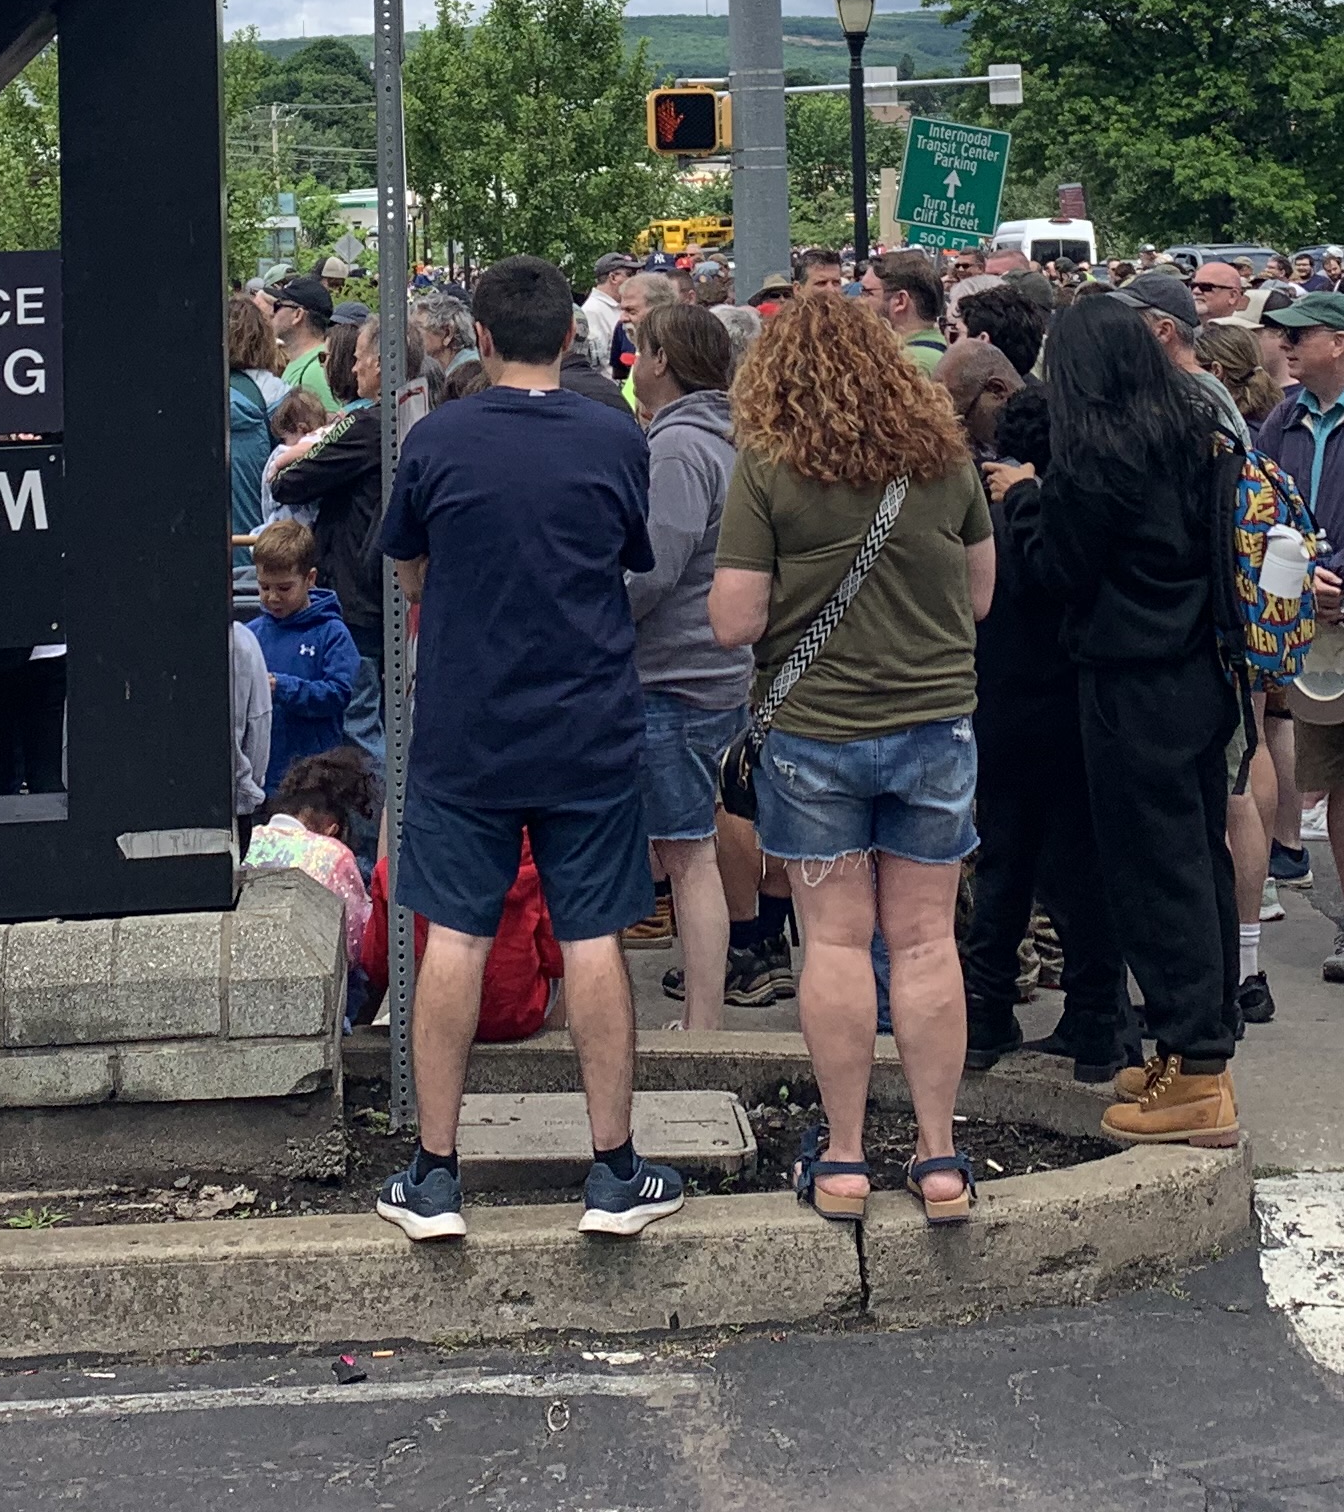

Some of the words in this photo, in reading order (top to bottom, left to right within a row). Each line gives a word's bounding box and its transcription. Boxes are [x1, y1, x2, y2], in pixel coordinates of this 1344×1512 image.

[929, 124, 992, 147] Intermodal
[917, 135, 956, 154] Transit
[961, 144, 1000, 162] Center
[934, 153, 977, 176] Parking
[923, 194, 947, 211] Turn
[952, 200, 975, 216] Left
[913, 208, 938, 224] Cliff
[942, 213, 979, 230] Street
[919, 232, 946, 246] 500
[951, 238, 968, 249] FT
